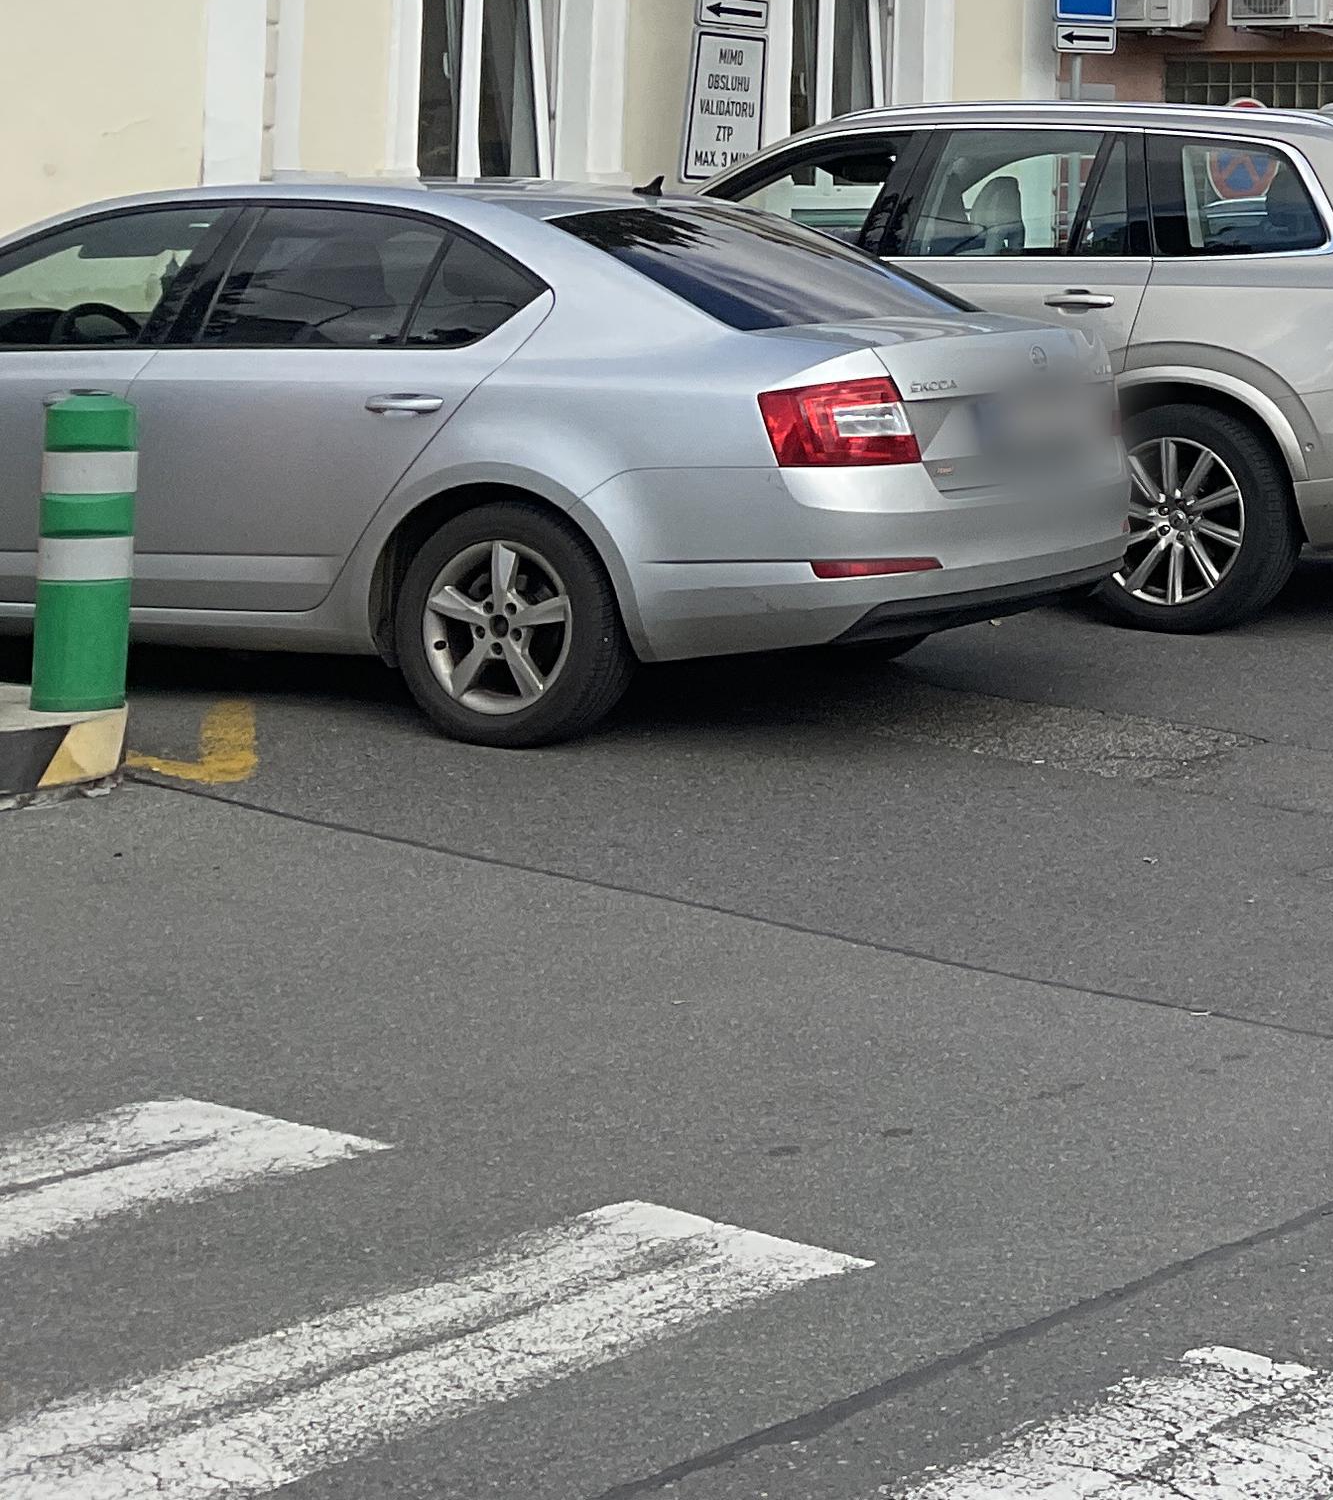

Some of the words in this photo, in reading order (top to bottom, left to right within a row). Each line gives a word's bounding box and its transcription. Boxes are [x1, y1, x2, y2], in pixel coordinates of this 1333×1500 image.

[719, 48, 744, 66] MIMO
[707, 73, 750, 92] OBSLUHU
[700, 96, 755, 118] VALIDÁTORU
[715, 125, 734, 142] ZTP
[694, 149, 718, 167] MAX.
[721, 151, 728, 167] 3
